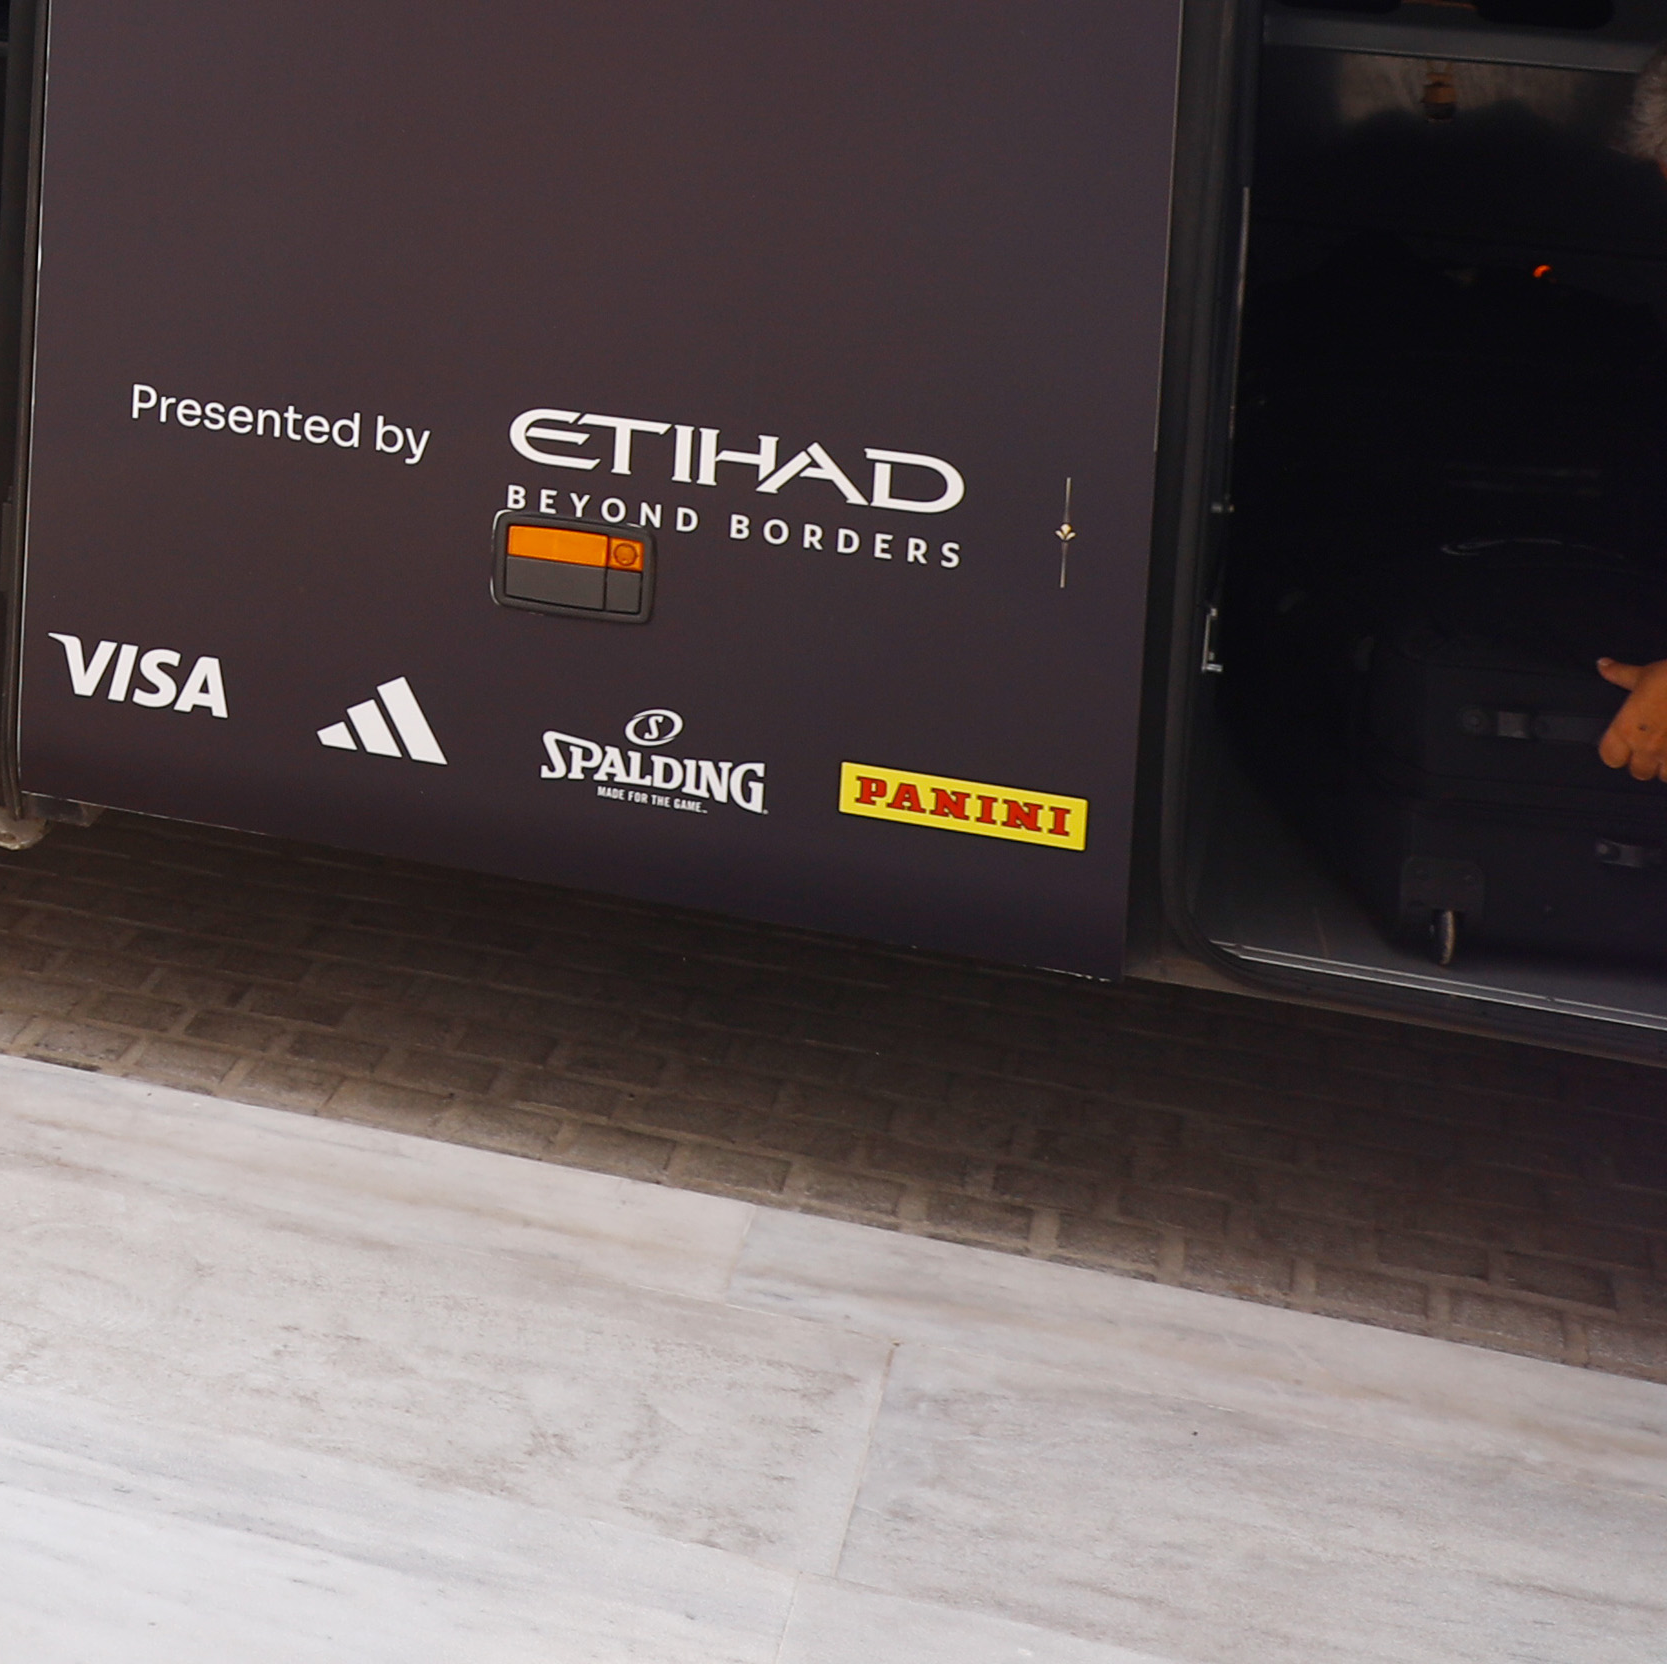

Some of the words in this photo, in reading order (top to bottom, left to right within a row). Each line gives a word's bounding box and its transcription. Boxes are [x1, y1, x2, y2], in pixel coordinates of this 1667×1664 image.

[132, 383, 361, 448] Presented
[375, 415, 431, 465] by
[509, 408, 965, 514] ETIHAD
[506, 484, 699, 533] BEYOND
[729, 514, 962, 568] BORDERS
[48, 632, 229, 718] VISA
[540, 730, 769, 814] SPALDING
[597, 785, 626, 801] MADE
[627, 790, 649, 804] FOR
[650, 794, 671, 808] THE
[855, 776, 1071, 836] PANINI
